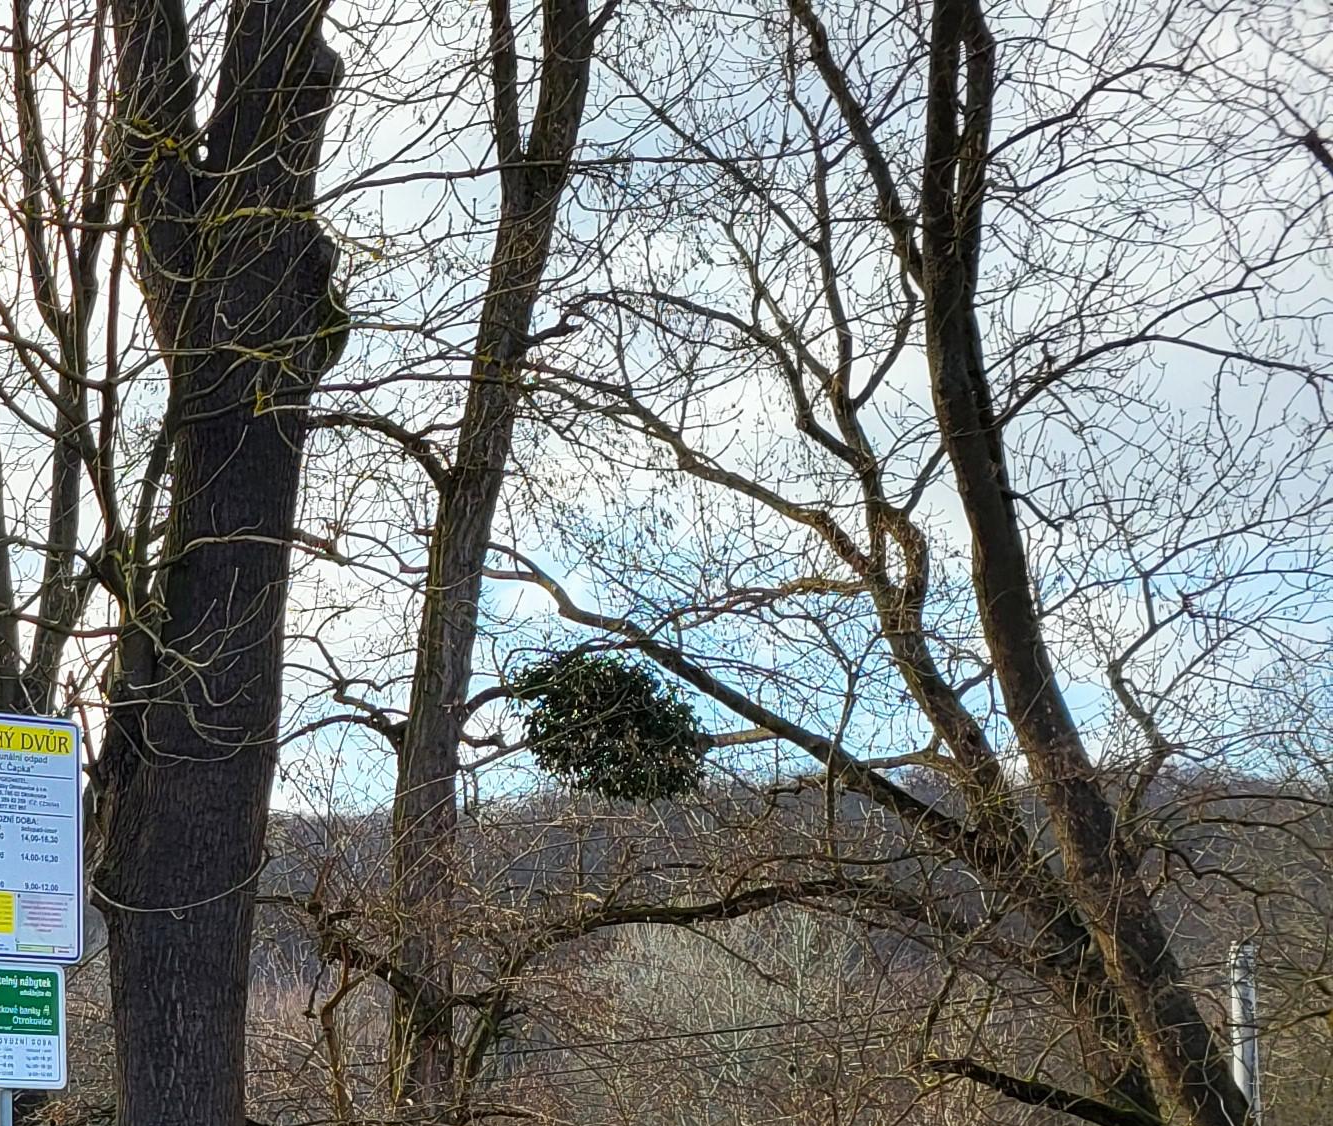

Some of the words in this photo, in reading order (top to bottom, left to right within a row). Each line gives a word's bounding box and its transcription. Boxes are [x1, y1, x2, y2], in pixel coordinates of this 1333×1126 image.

[21, 729, 69, 753] DVŮR
[24, 755, 48, 764] odpad
[20, 977, 51, 989] nábytek
[13, 1016, 52, 1026] Otrokovice
